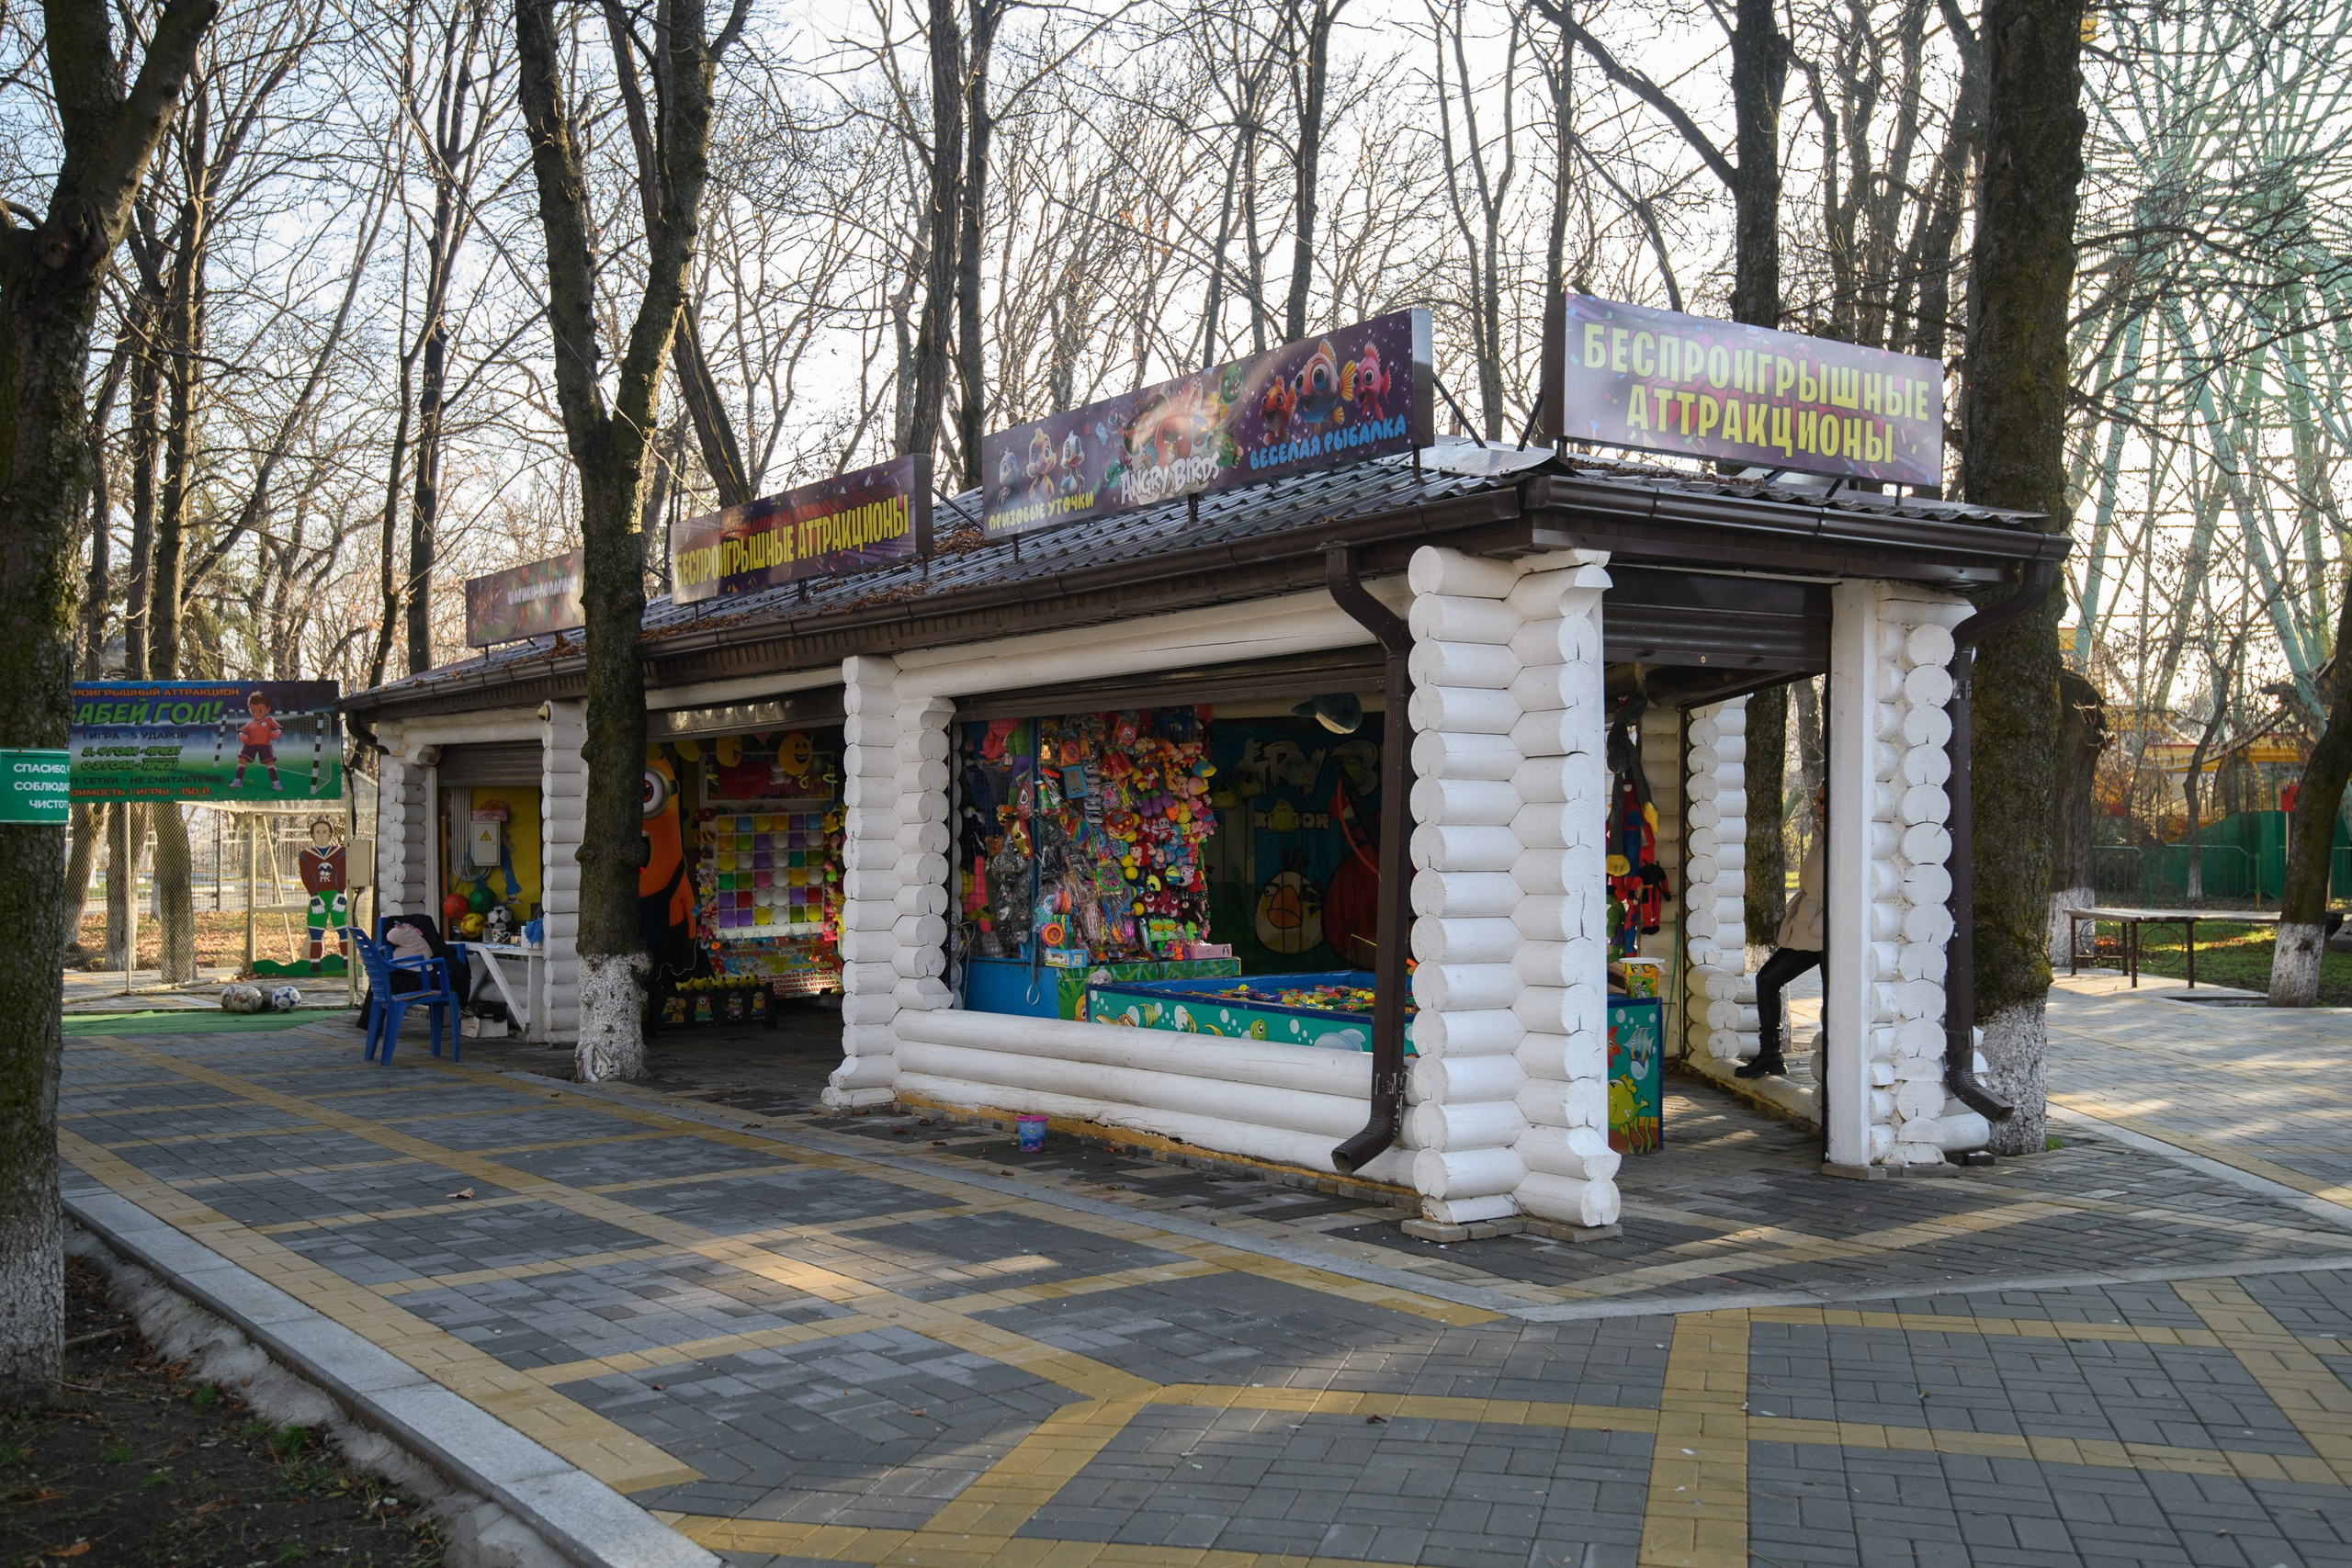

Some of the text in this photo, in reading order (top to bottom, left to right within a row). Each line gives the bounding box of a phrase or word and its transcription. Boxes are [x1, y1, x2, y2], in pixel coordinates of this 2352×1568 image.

[1582, 322, 1929, 422] БЕСПРОИГРЫШНЫЕ
[1626, 385, 1894, 464] АТТРАКЦИОНЫ
[1250, 413, 1408, 470] ВЕСЕЛАЯ РЫБАЛКА
[1121, 451, 1221, 505] ANGRY BIRDS
[989, 491, 1095, 531] ПРИЗОВЫЕ УТОЧКИ
[674, 493, 910, 588] БЕСПРОИГРЫШНЫЕ АТТРАКЦИОНЫ
[73, 688, 239, 697] РОИГРЫШНЫЙ АТТРАКЦИОН
[152, 702, 224, 725] ГОЛ!
[141, 731, 188, 740] УДАРОВ
[106, 746, 139, 756] ГОЛА
[144, 745, 183, 756] ПРИЗ!
[14, 763, 66, 774] СПАСИБО,
[102, 760, 135, 771] ГОЛА
[141, 761, 179, 771] ПРИЗ!
[14, 782, 70, 793] СОБЛЮДАЕ
[71, 788, 126, 796] ОИМОСТЬ
[136, 787, 169, 795] ИГРЫ
[179, 787, 198, 795] 150
[201, 787, 213, 795] Р.
